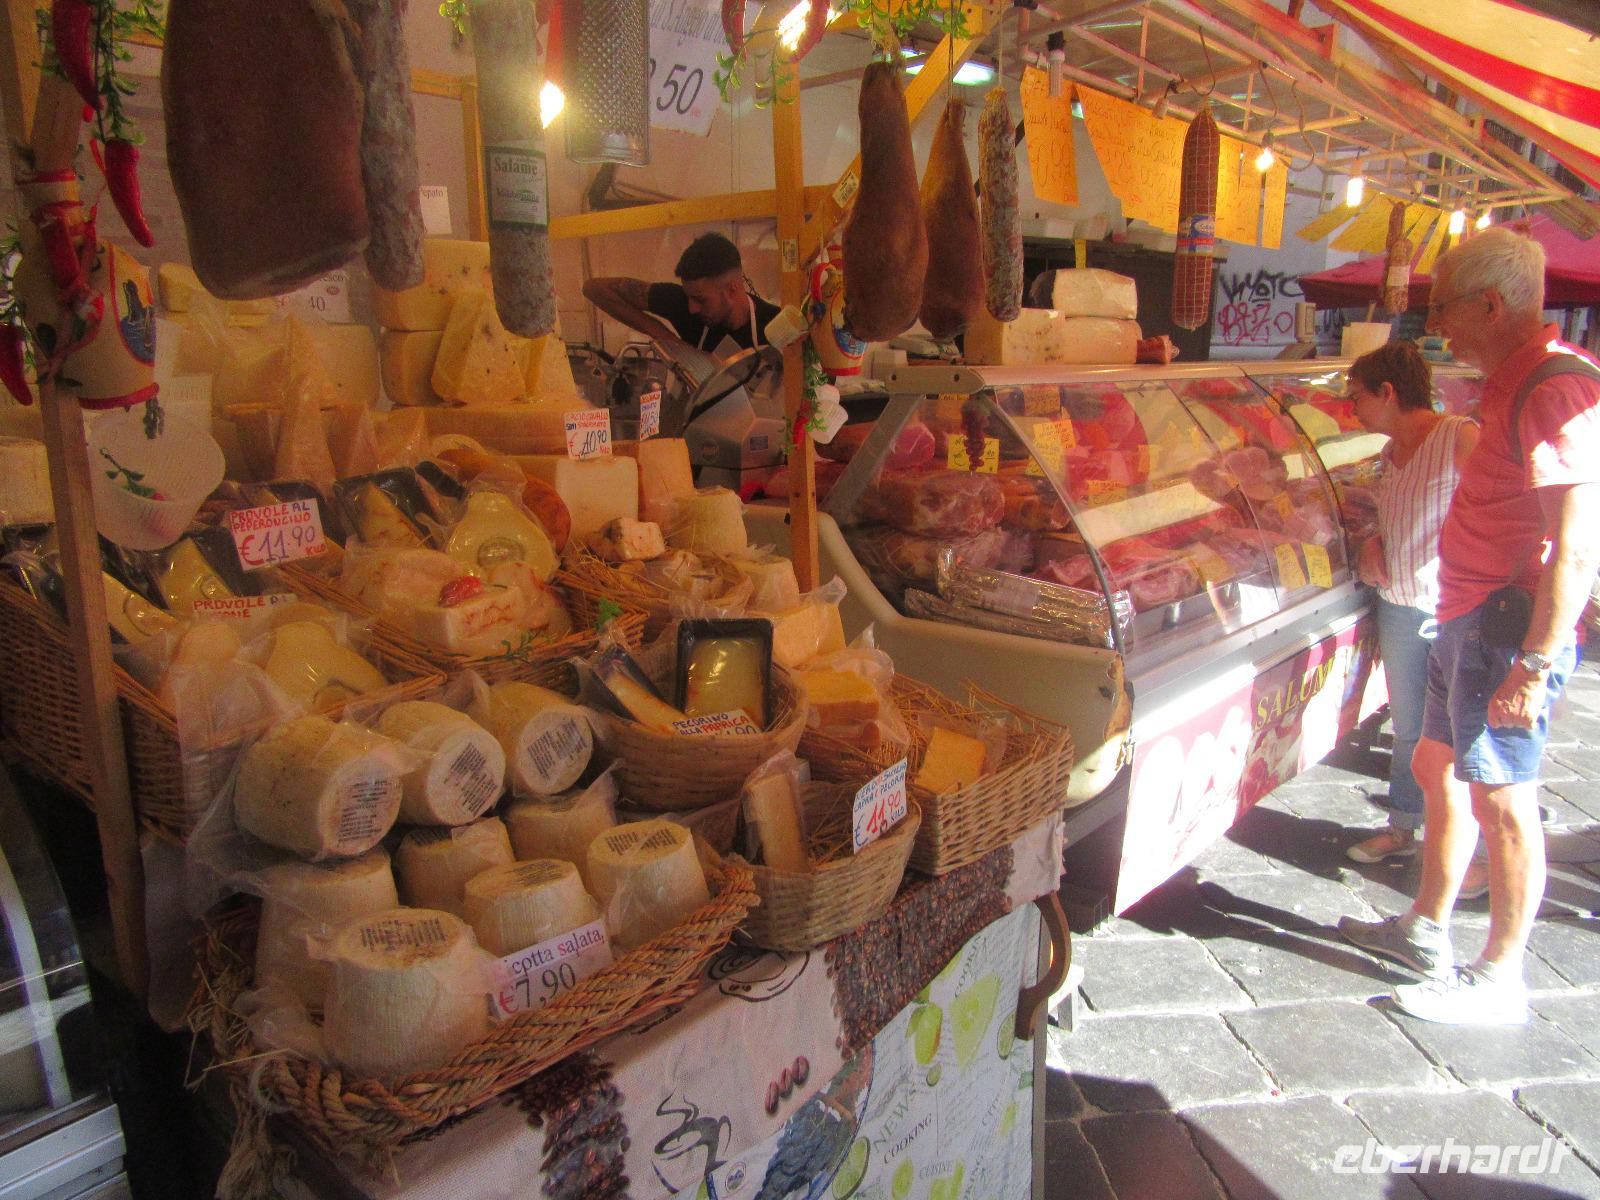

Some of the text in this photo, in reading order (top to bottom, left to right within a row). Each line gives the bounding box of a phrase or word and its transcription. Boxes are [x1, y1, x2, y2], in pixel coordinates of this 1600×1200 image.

[650, 58, 704, 115] 50
[494, 157, 538, 175] Salame
[231, 501, 310, 523] PROVOLE AL
[193, 596, 266, 610] PROVOLE
[672, 712, 729, 729] PECORINO
[702, 715, 749, 733] PAPRICA
[883, 1112, 932, 1164] COOKING
